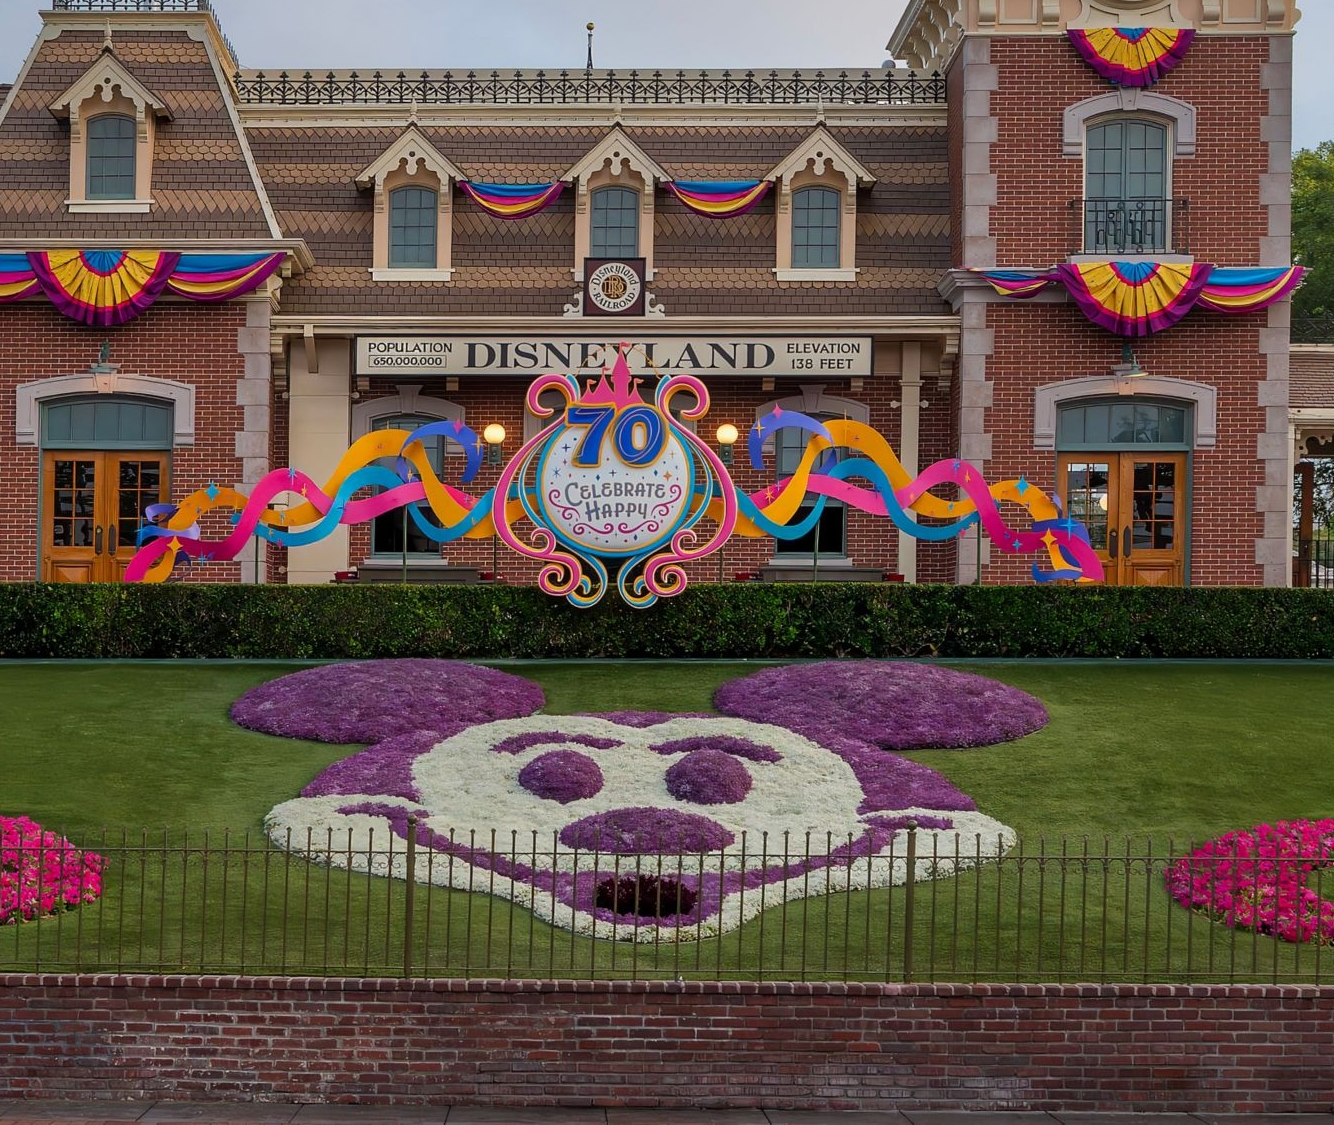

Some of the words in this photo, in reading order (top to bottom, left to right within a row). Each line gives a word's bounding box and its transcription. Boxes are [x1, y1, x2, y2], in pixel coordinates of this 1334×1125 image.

[591, 265, 640, 286] Disneyland
[593, 292, 636, 309] RAILROAD
[368, 342, 453, 354] POPULATION
[463, 342, 776, 369] DISNEYLAND
[787, 343, 861, 354] ELEVATION
[791, 358, 814, 369] 138
[820, 358, 854, 369] FEET
[565, 402, 669, 468] 70
[565, 482, 666, 507] CELEBRATE
[585, 500, 648, 522] HAPPY
